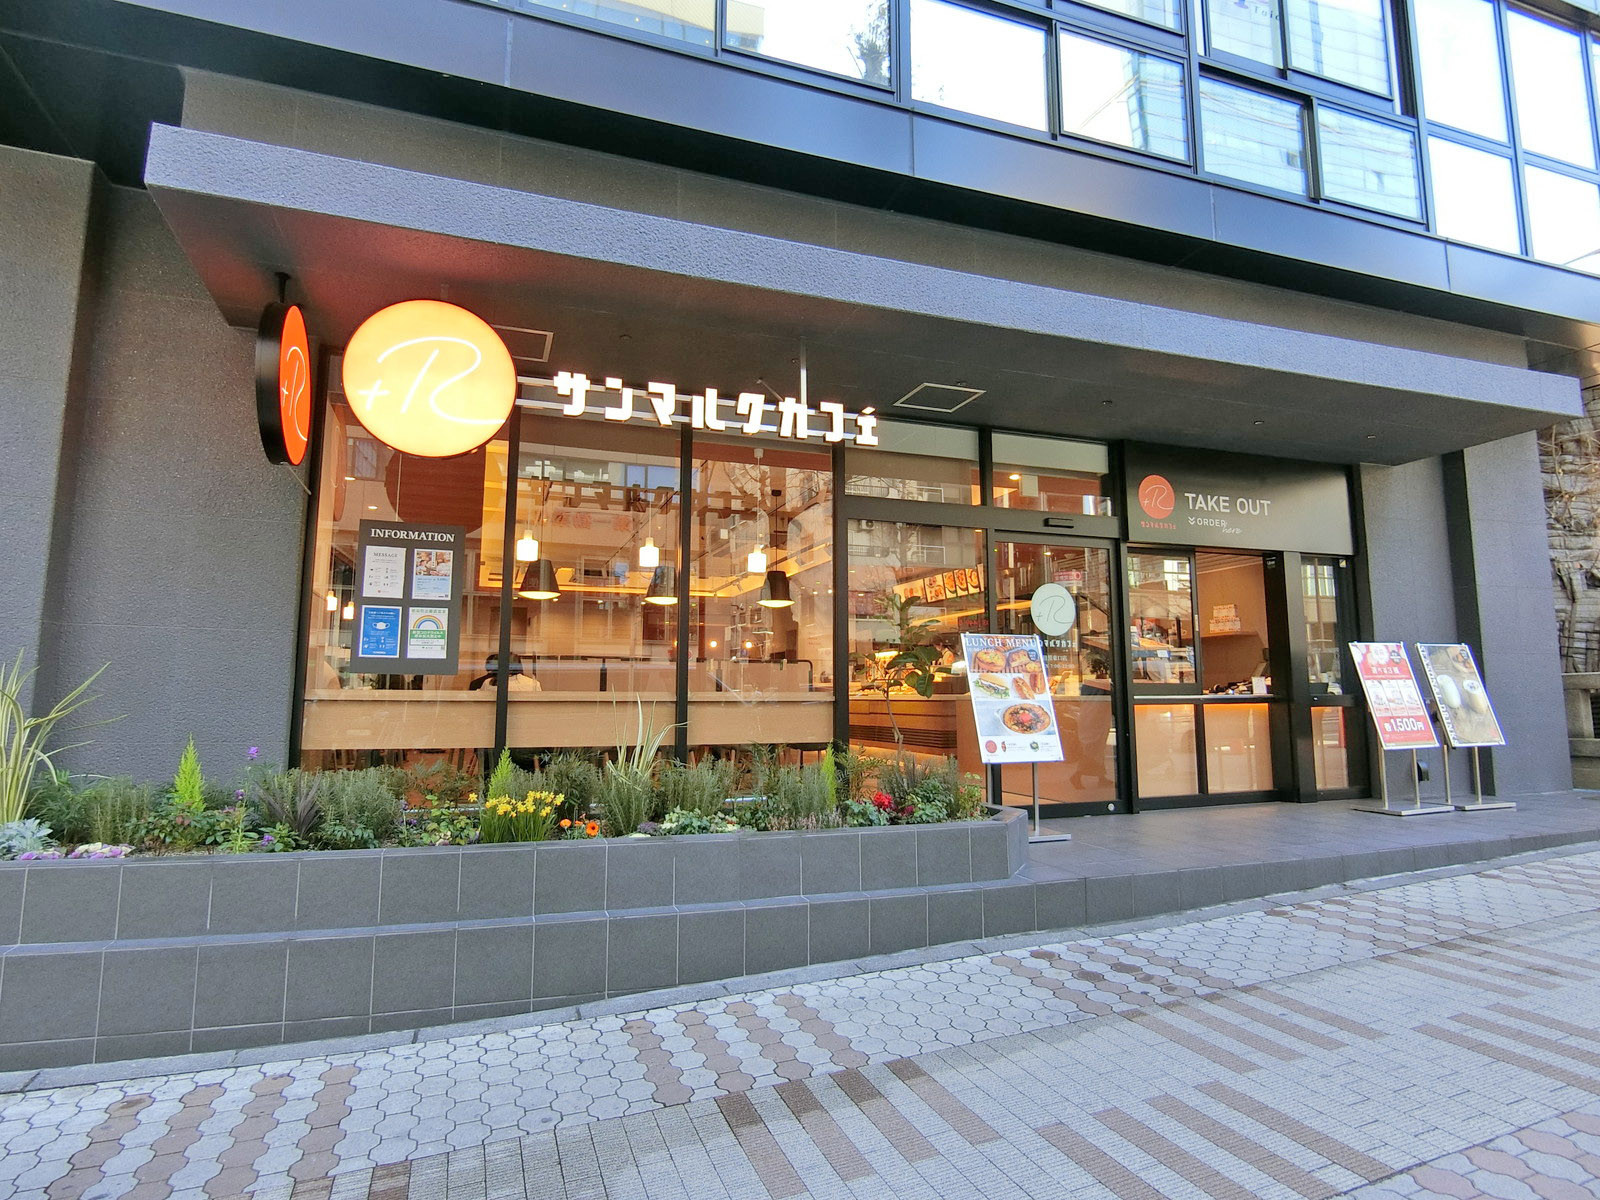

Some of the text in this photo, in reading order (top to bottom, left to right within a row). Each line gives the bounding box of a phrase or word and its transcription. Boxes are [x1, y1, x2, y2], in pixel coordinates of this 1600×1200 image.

[553, 371, 879, 447] サンマルクカフェ
[1184, 492, 1271, 516] TAKE OUT
[1197, 517, 1227, 528] ORDER
[370, 528, 455, 543] INFORMATION
[965, 637, 1037, 647] LUNCH MENU
[1439, 704, 1460, 745] DRINKS
